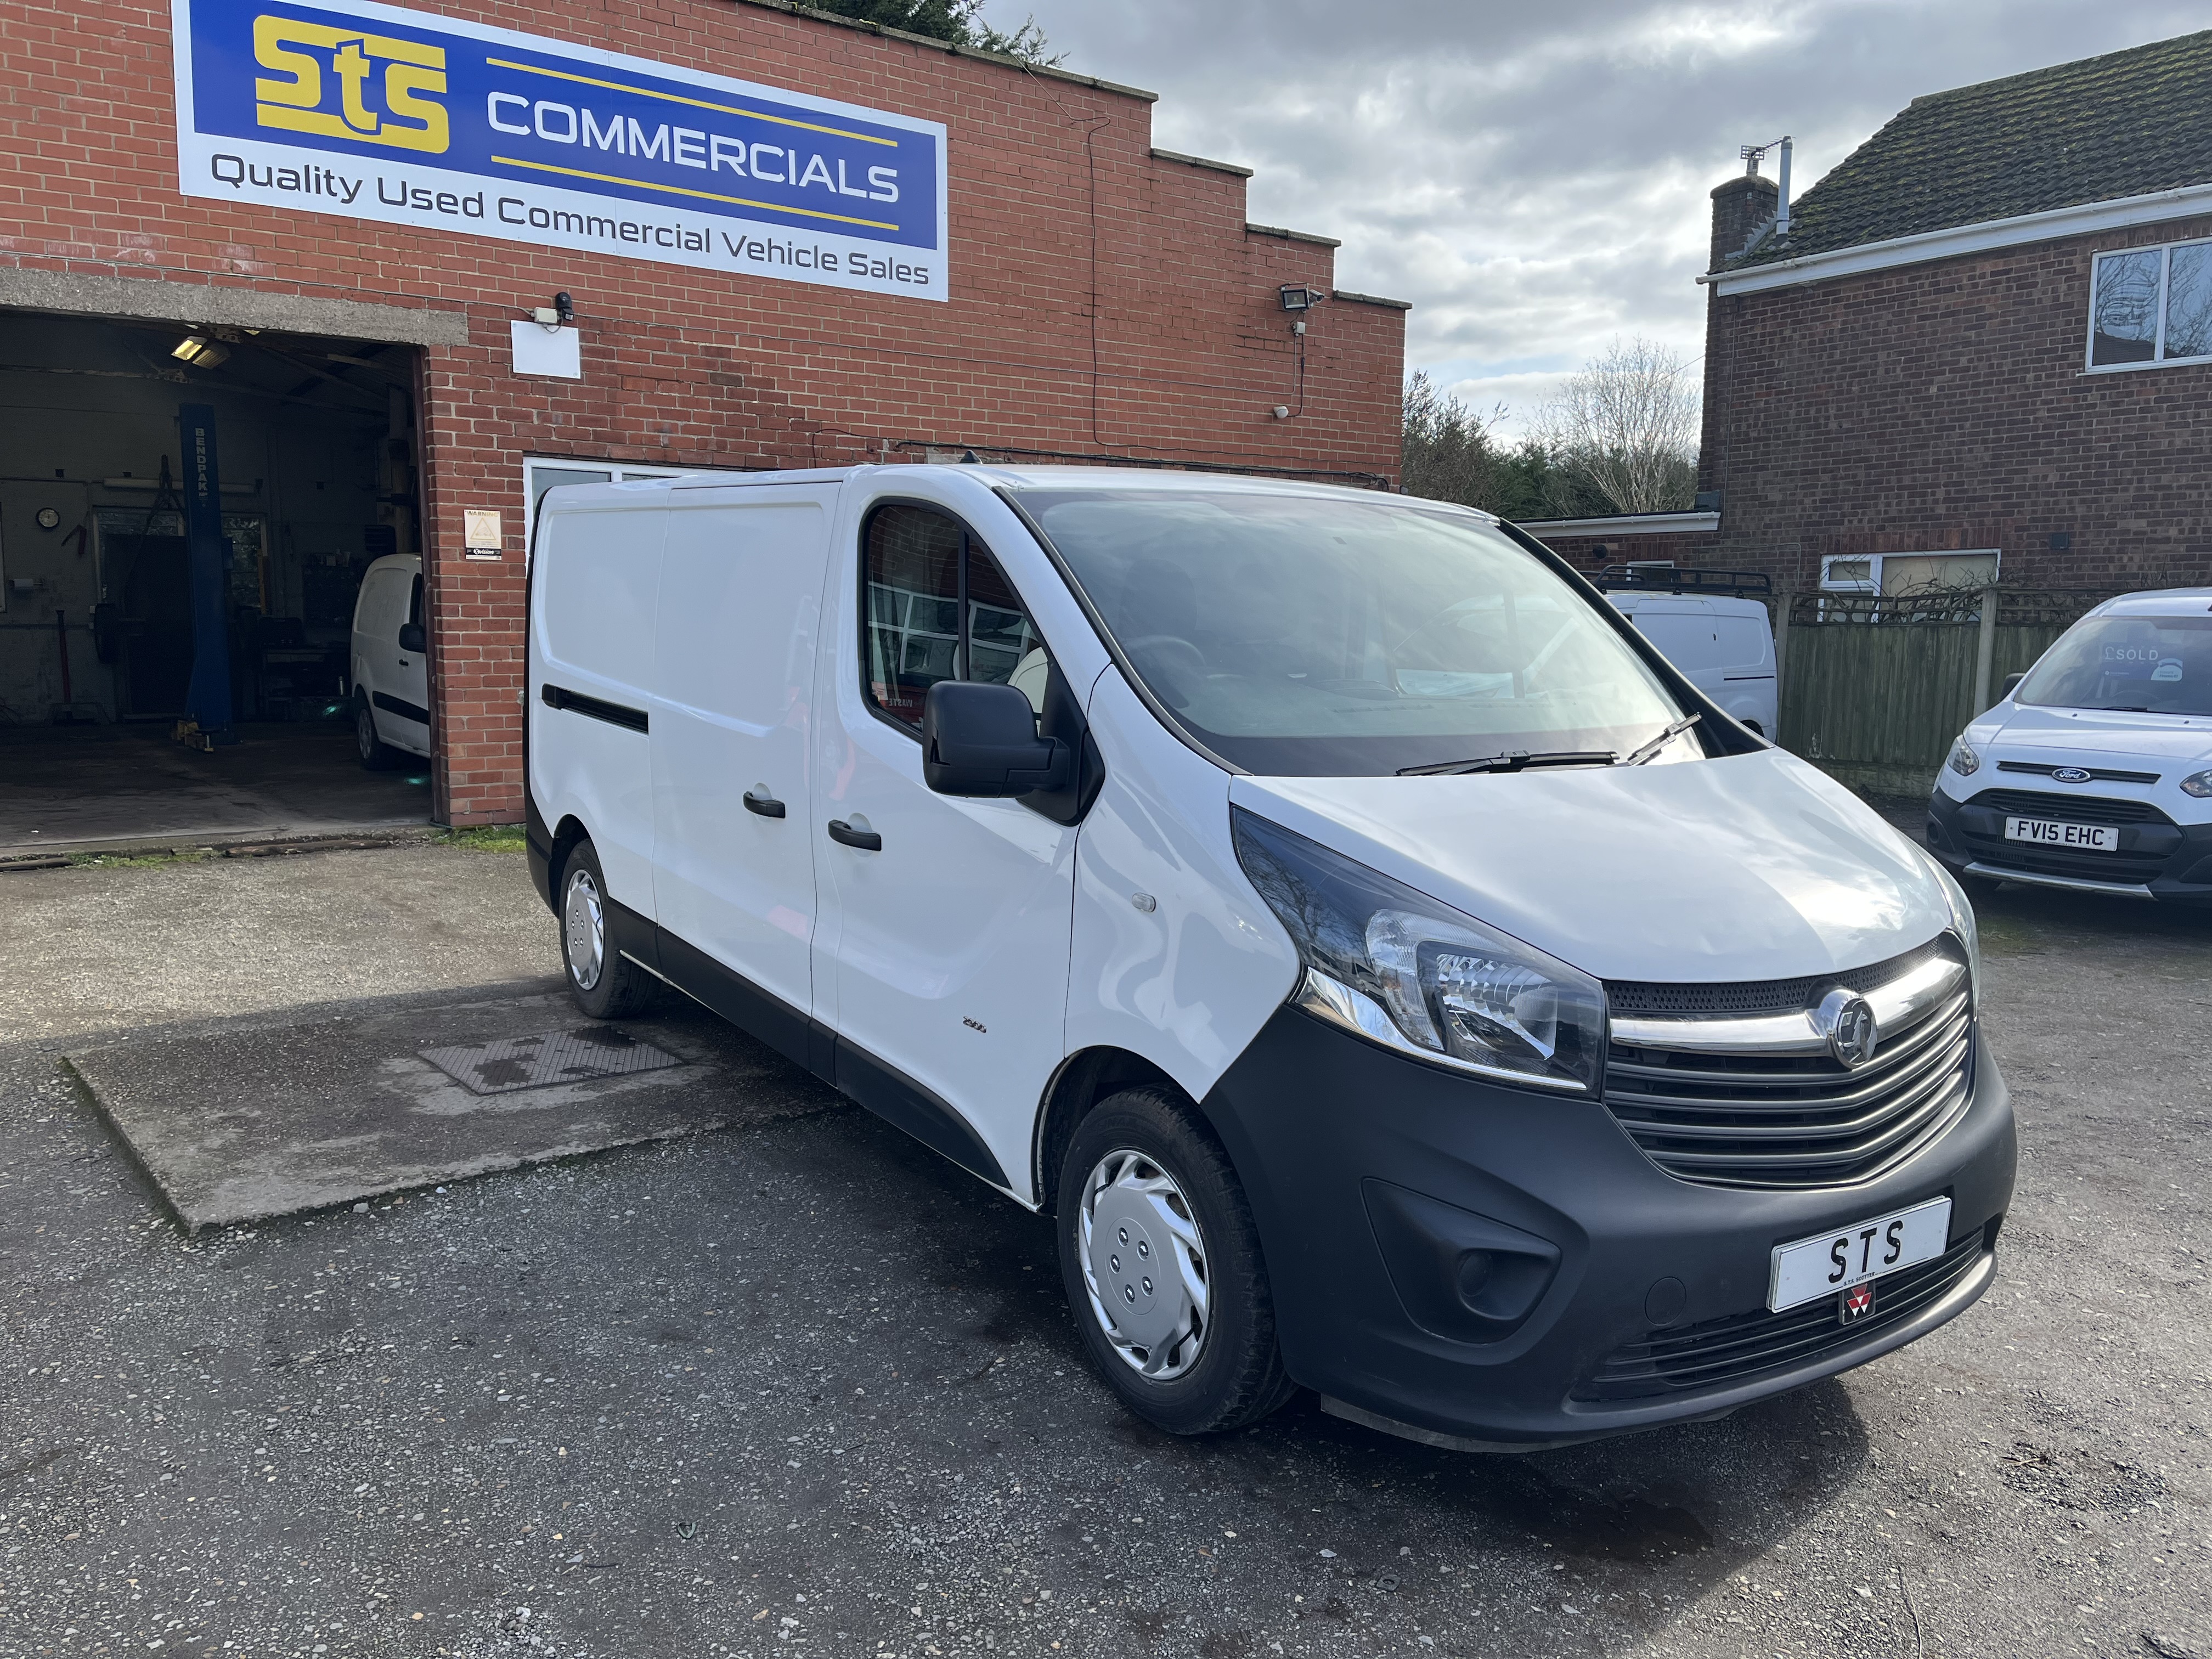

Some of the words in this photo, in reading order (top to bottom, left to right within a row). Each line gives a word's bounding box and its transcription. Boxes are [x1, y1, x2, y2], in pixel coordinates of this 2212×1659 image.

[487, 91, 899, 202] COMMERCIALS
[212, 154, 363, 204] Quality
[377, 177, 484, 219] Used
[498, 197, 710, 253] Commercial
[721, 232, 838, 272] Vehicle
[849, 252, 928, 285] Sales
[195, 428, 207, 490] BENDPAK
[2059, 770, 2081, 779] Ford
[2017, 821, 2058, 840] FV15
[2065, 826, 2104, 845] EHC
[1855, 1272, 1875, 1282] SCOTTER
